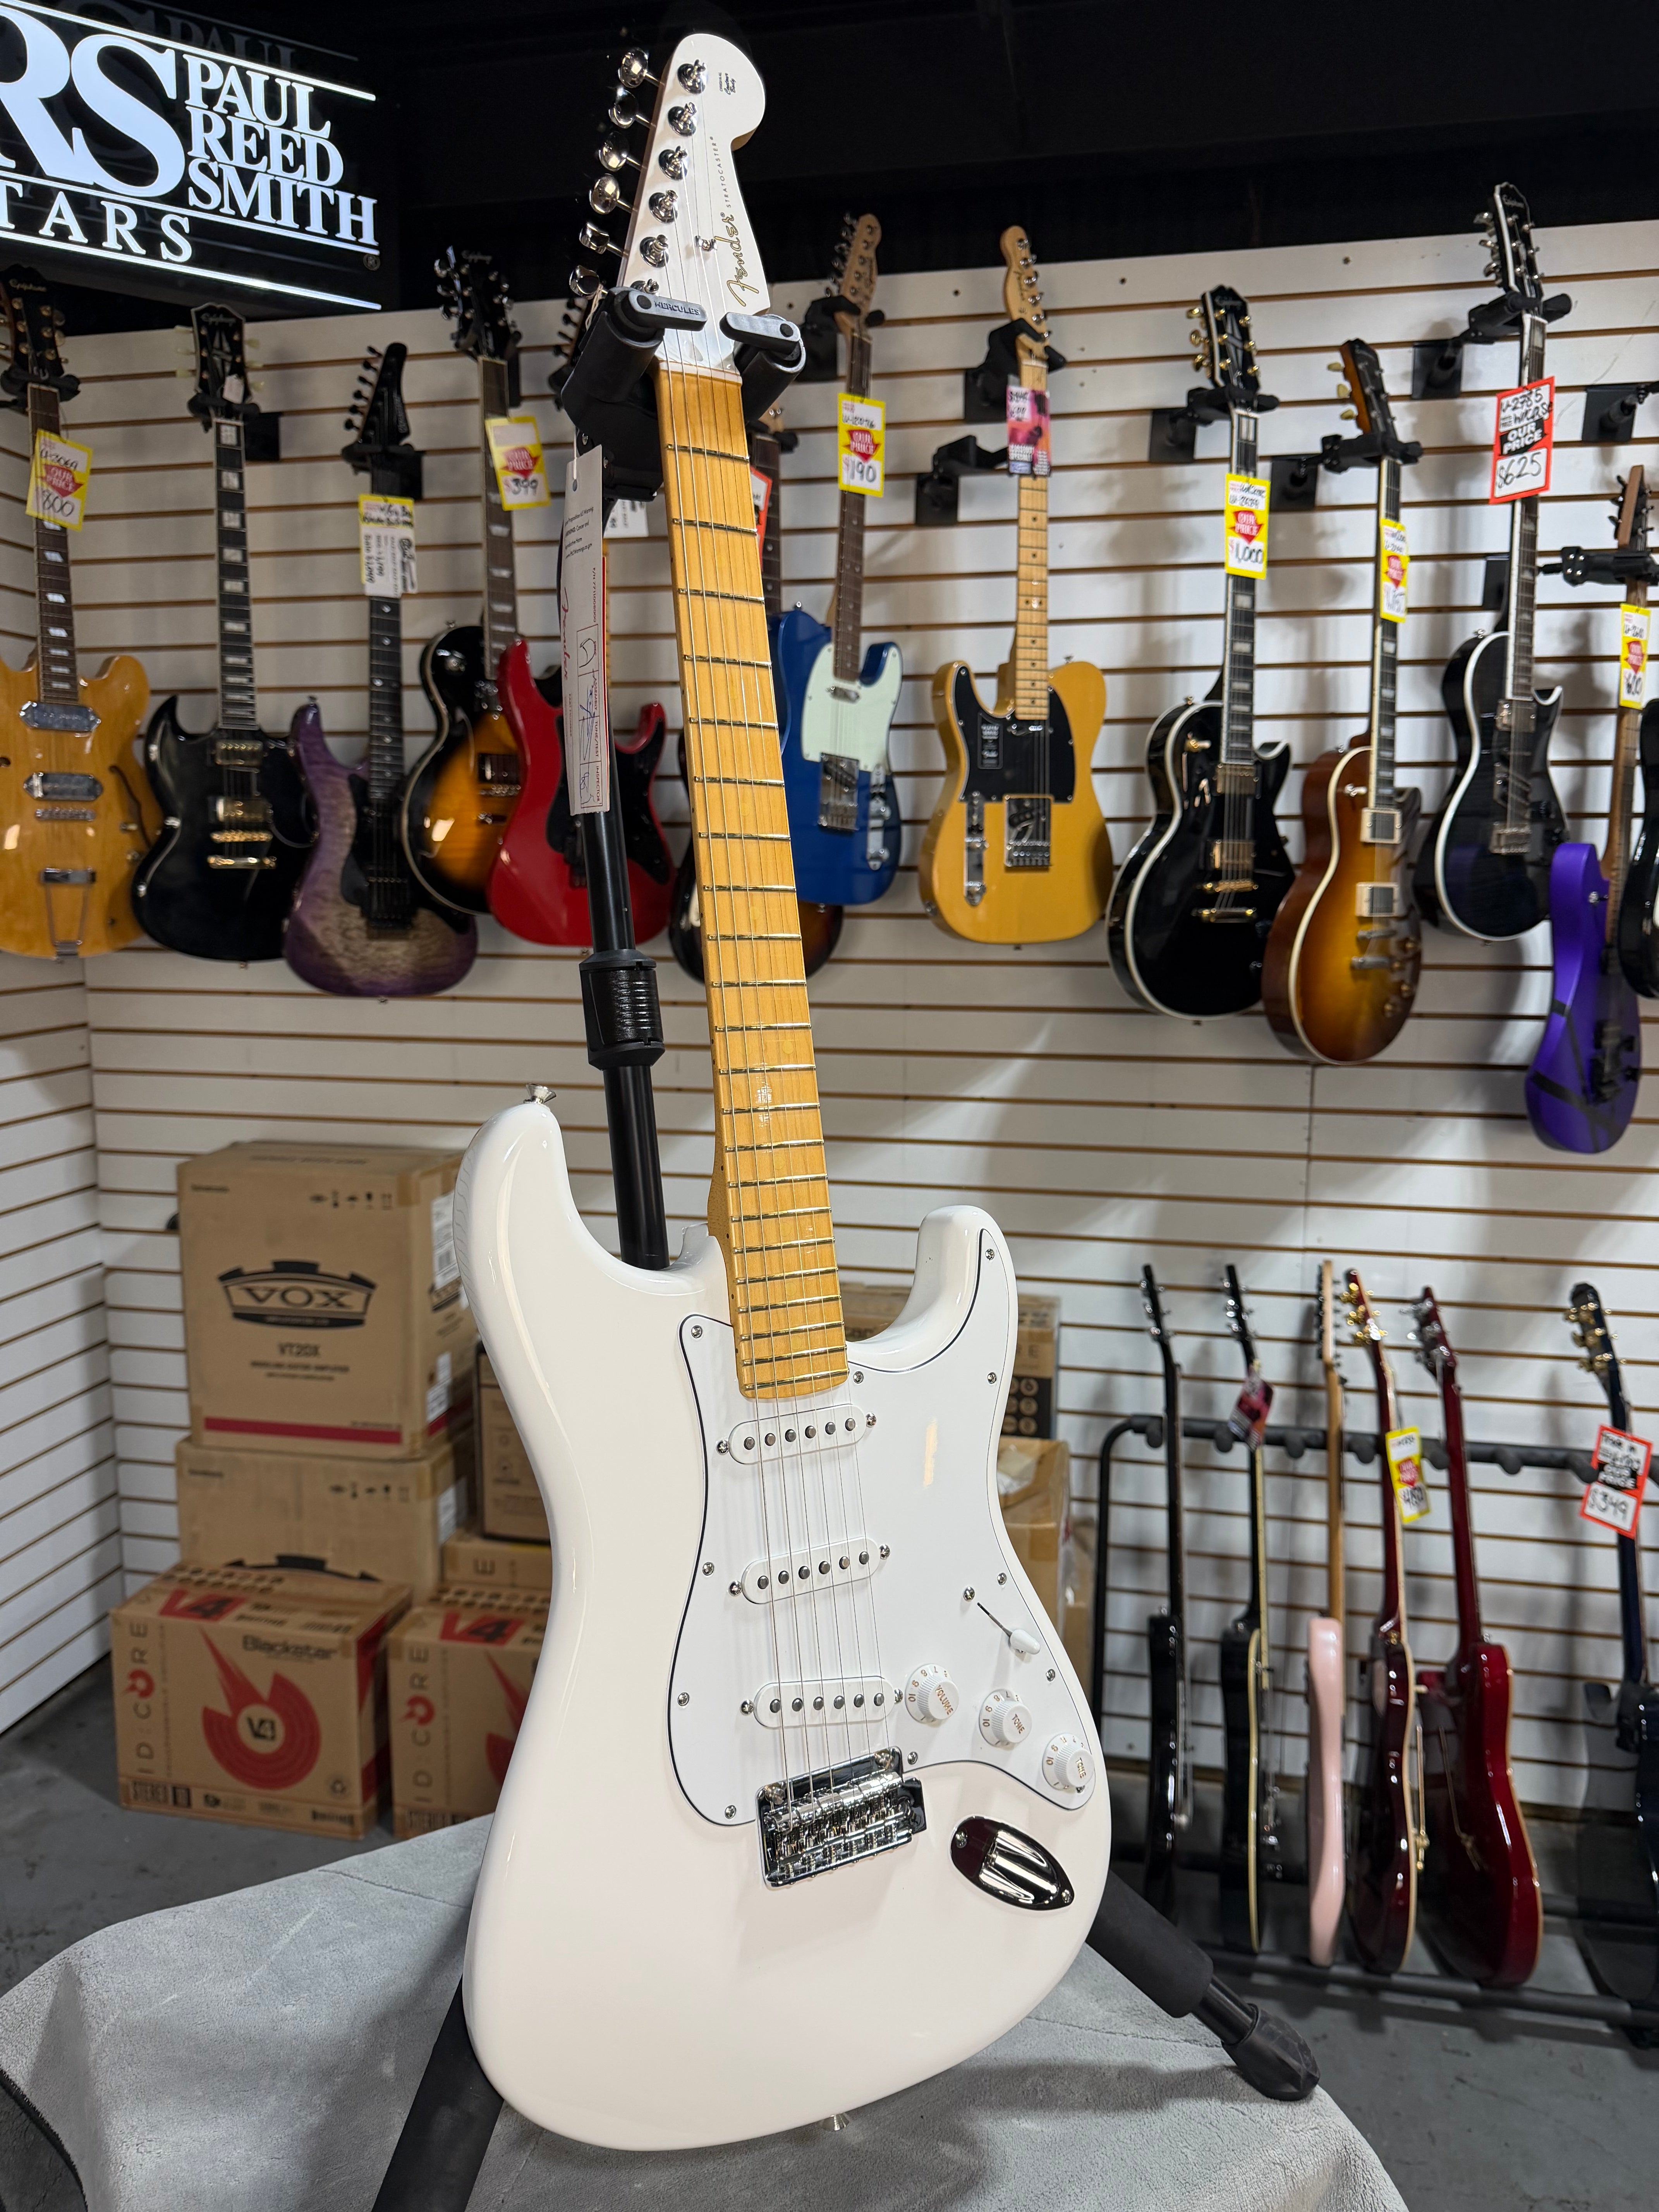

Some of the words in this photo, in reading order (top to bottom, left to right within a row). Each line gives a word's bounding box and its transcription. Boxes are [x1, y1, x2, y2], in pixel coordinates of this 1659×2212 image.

[183, 53, 330, 139] PAUL
[185, 105, 343, 187] REED
[712, 142, 731, 208] STRATOCASTER
[188, 159, 379, 246] SMITH
[714, 215, 759, 307] Fender
[654, 301, 701, 315] HERCULES
[853, 431, 873, 444] OUR
[1503, 428, 1543, 455] PRICE
[1508, 422, 1533, 442] OUR
[850, 441, 874, 455] PRICE
[51, 467, 74, 482] OUR
[1498, 452, 1542, 489] $625
[46, 475, 75, 493] PRICE
[1238, 512, 1256, 525] OUR
[1235, 523, 1258, 536] PRICE
[239, 1286, 353, 1309] VOX
[1598, 1471, 1637, 1490] PRICE
[908, 1693, 916, 1702] 10
[935, 1685, 954, 1715] VOLUME
[1012, 1714, 1025, 1734] TONE
[1046, 1756, 1054, 1765] 10
[1075, 1757, 1086, 1778] TONE
